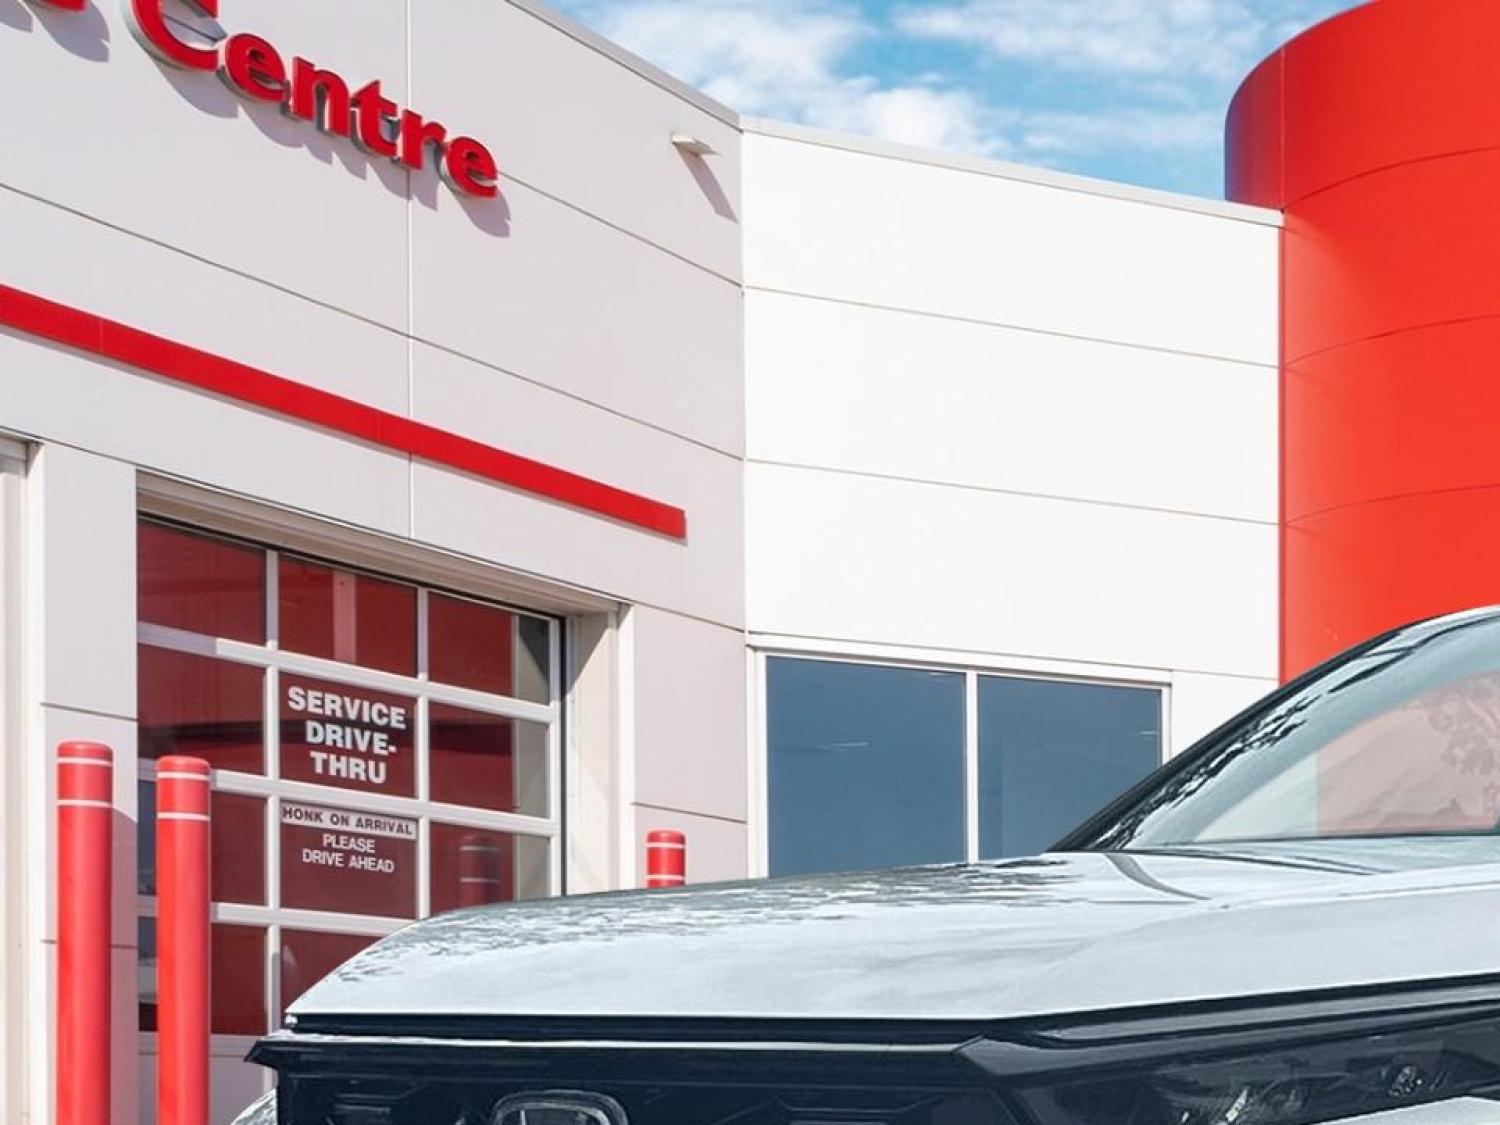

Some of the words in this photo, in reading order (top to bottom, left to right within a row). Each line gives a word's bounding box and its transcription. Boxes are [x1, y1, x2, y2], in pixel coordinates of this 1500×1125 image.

[124, 0, 499, 199] Centre
[288, 686, 406, 729] SERVICE
[306, 720, 397, 756] DRIVE-
[310, 751, 387, 784] THRU
[282, 807, 323, 823] HONK
[330, 812, 349, 826] ON
[355, 817, 412, 835] ARRIVAL
[322, 833, 375, 852] PLEASE
[302, 848, 344, 867] DRIVE
[349, 855, 394, 873] AHEAD
